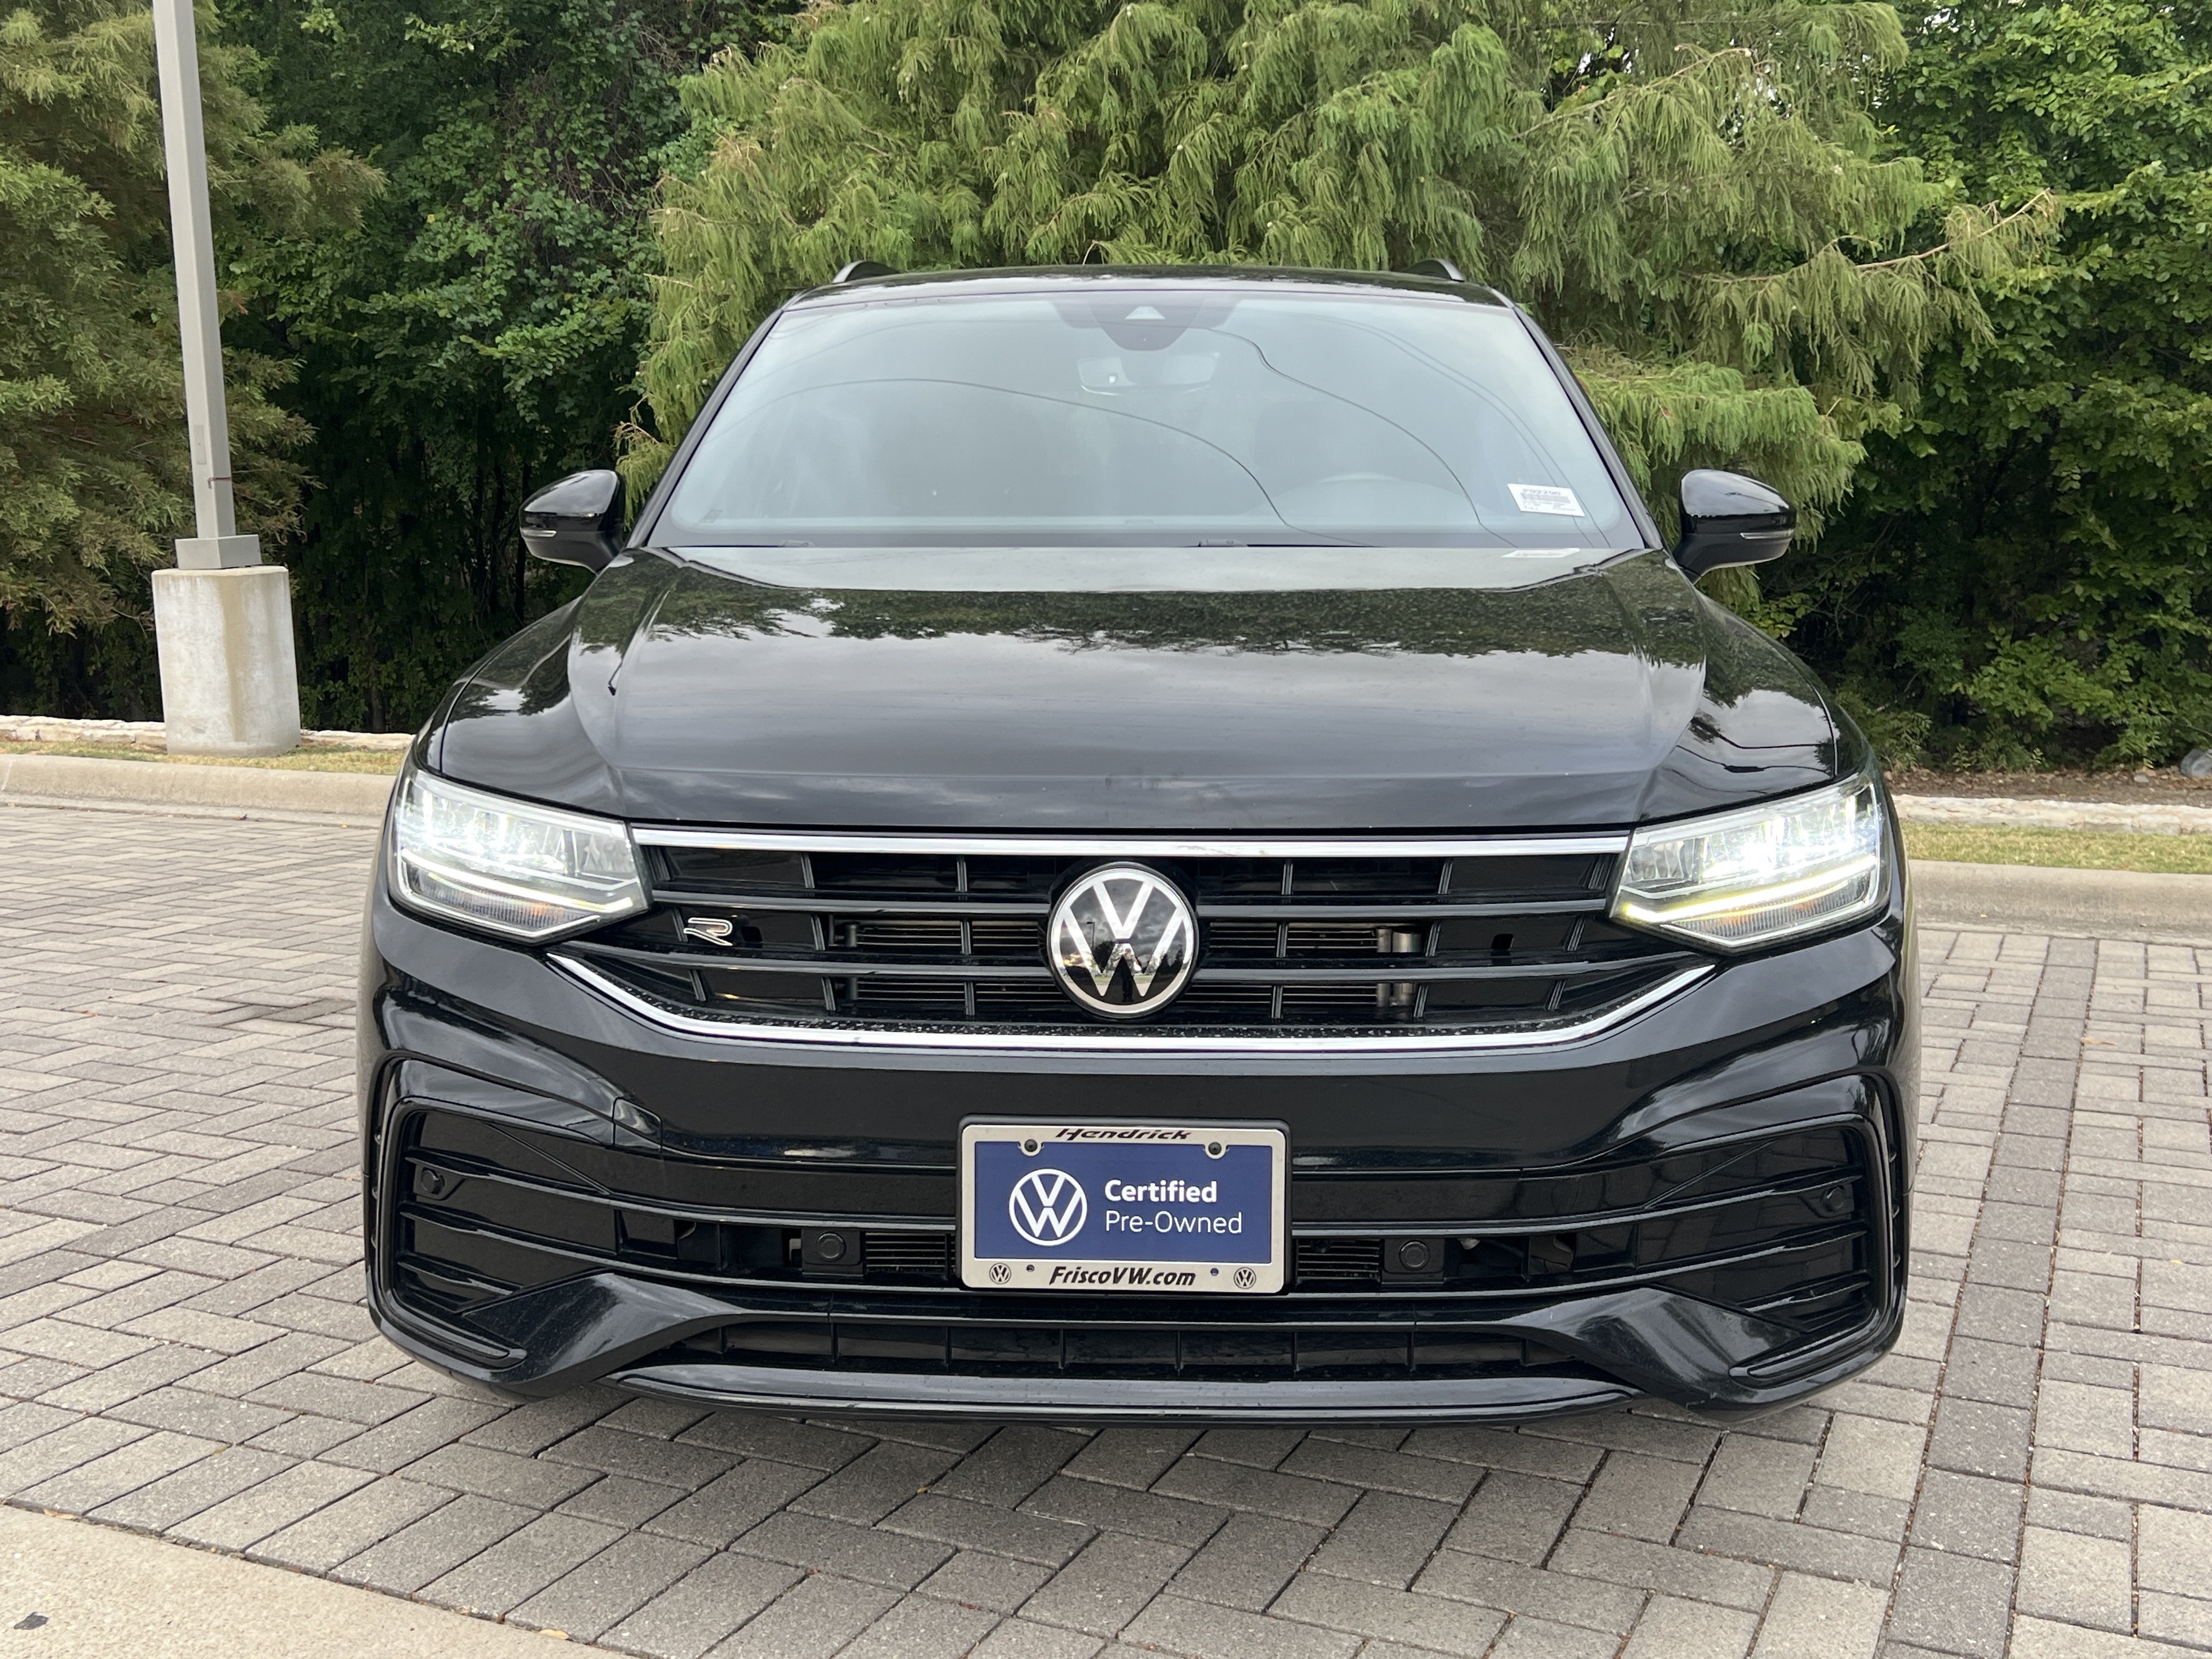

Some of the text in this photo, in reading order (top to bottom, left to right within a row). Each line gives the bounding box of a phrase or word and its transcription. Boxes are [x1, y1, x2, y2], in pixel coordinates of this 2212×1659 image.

[683, 917, 733, 946] R
[1051, 867, 1195, 1014] VW
[1056, 1128, 1192, 1141] Hendrick
[1104, 1179, 1217, 1203] Certified
[1009, 1169, 1087, 1246] VW
[1105, 1210, 1243, 1234] Pre-Owned
[1049, 1266, 1196, 1285] FriscoVW.com
